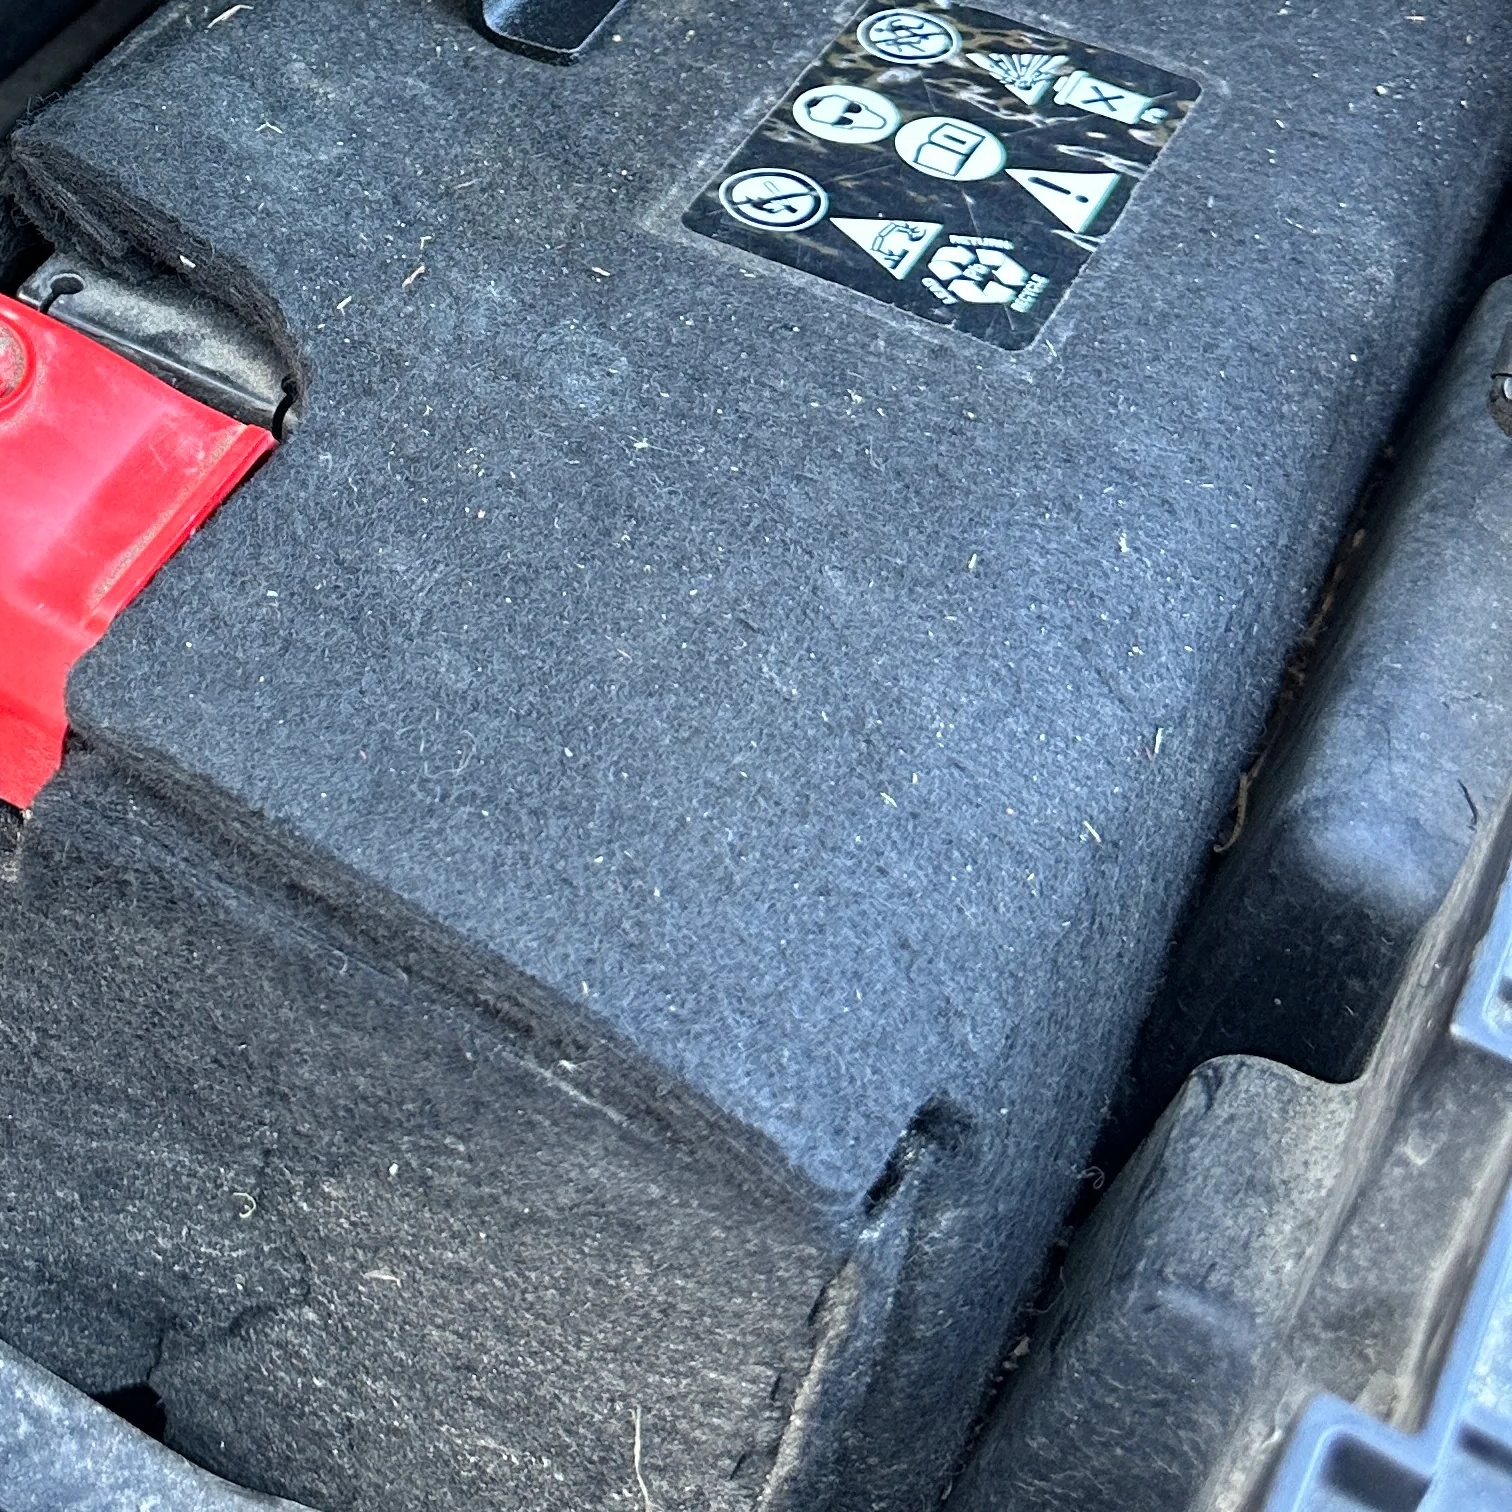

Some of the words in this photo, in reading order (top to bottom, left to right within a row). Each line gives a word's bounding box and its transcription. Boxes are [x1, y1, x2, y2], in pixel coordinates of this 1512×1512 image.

[962, 263, 991, 281] Pb
[921, 277, 959, 305] LEAD
[1010, 273, 1050, 313] RECYCLE
